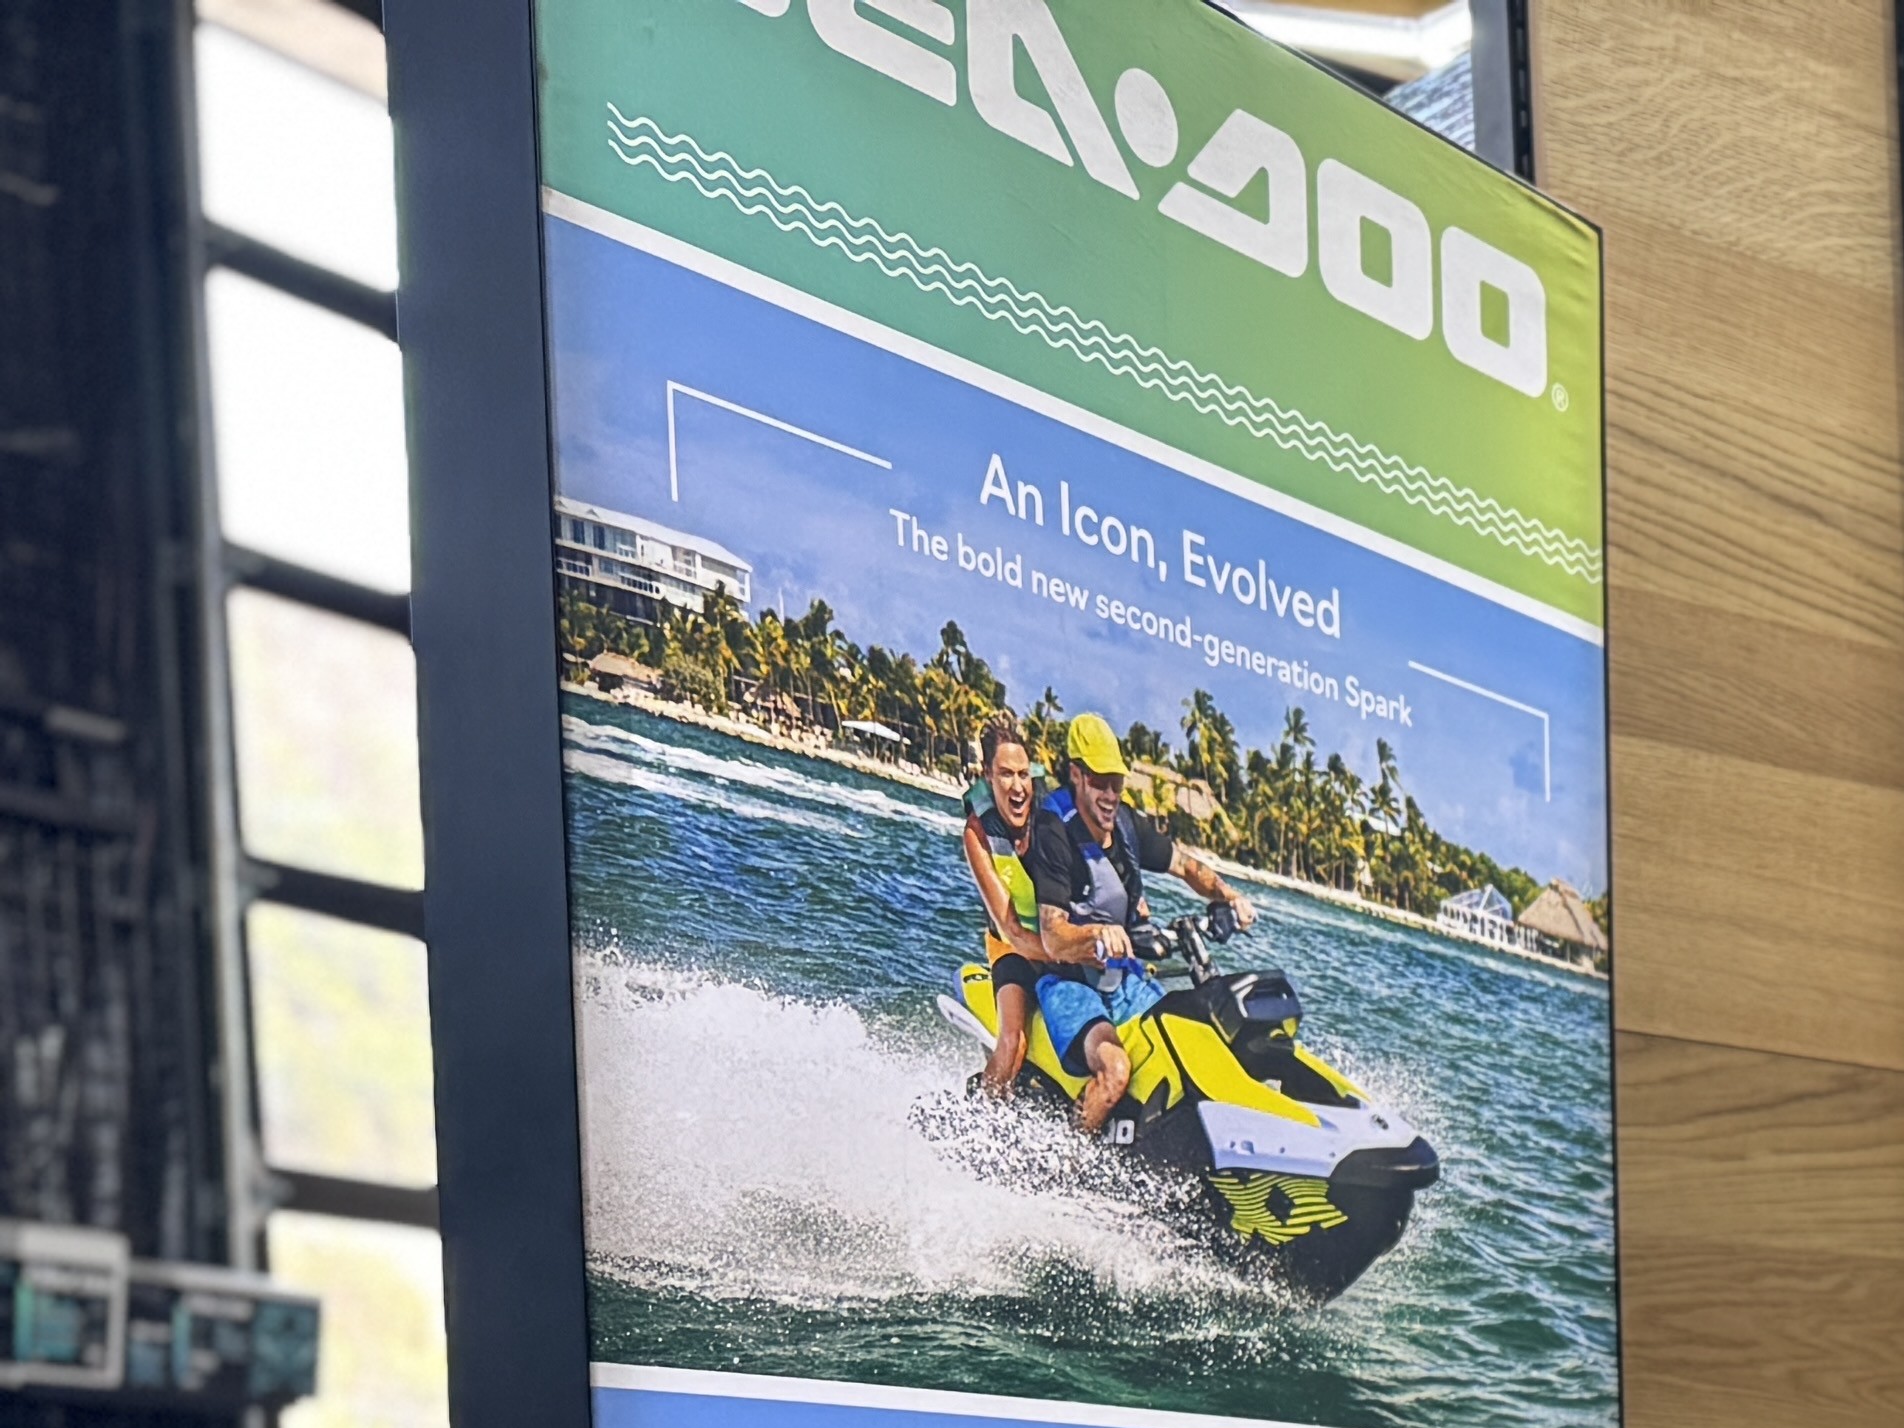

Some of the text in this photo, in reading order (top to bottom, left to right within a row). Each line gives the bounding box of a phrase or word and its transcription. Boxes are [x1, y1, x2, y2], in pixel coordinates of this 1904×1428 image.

[889, 508, 1413, 727] The bold new second-generation Spark
[979, 453, 1342, 639] An Icon, Evolved
